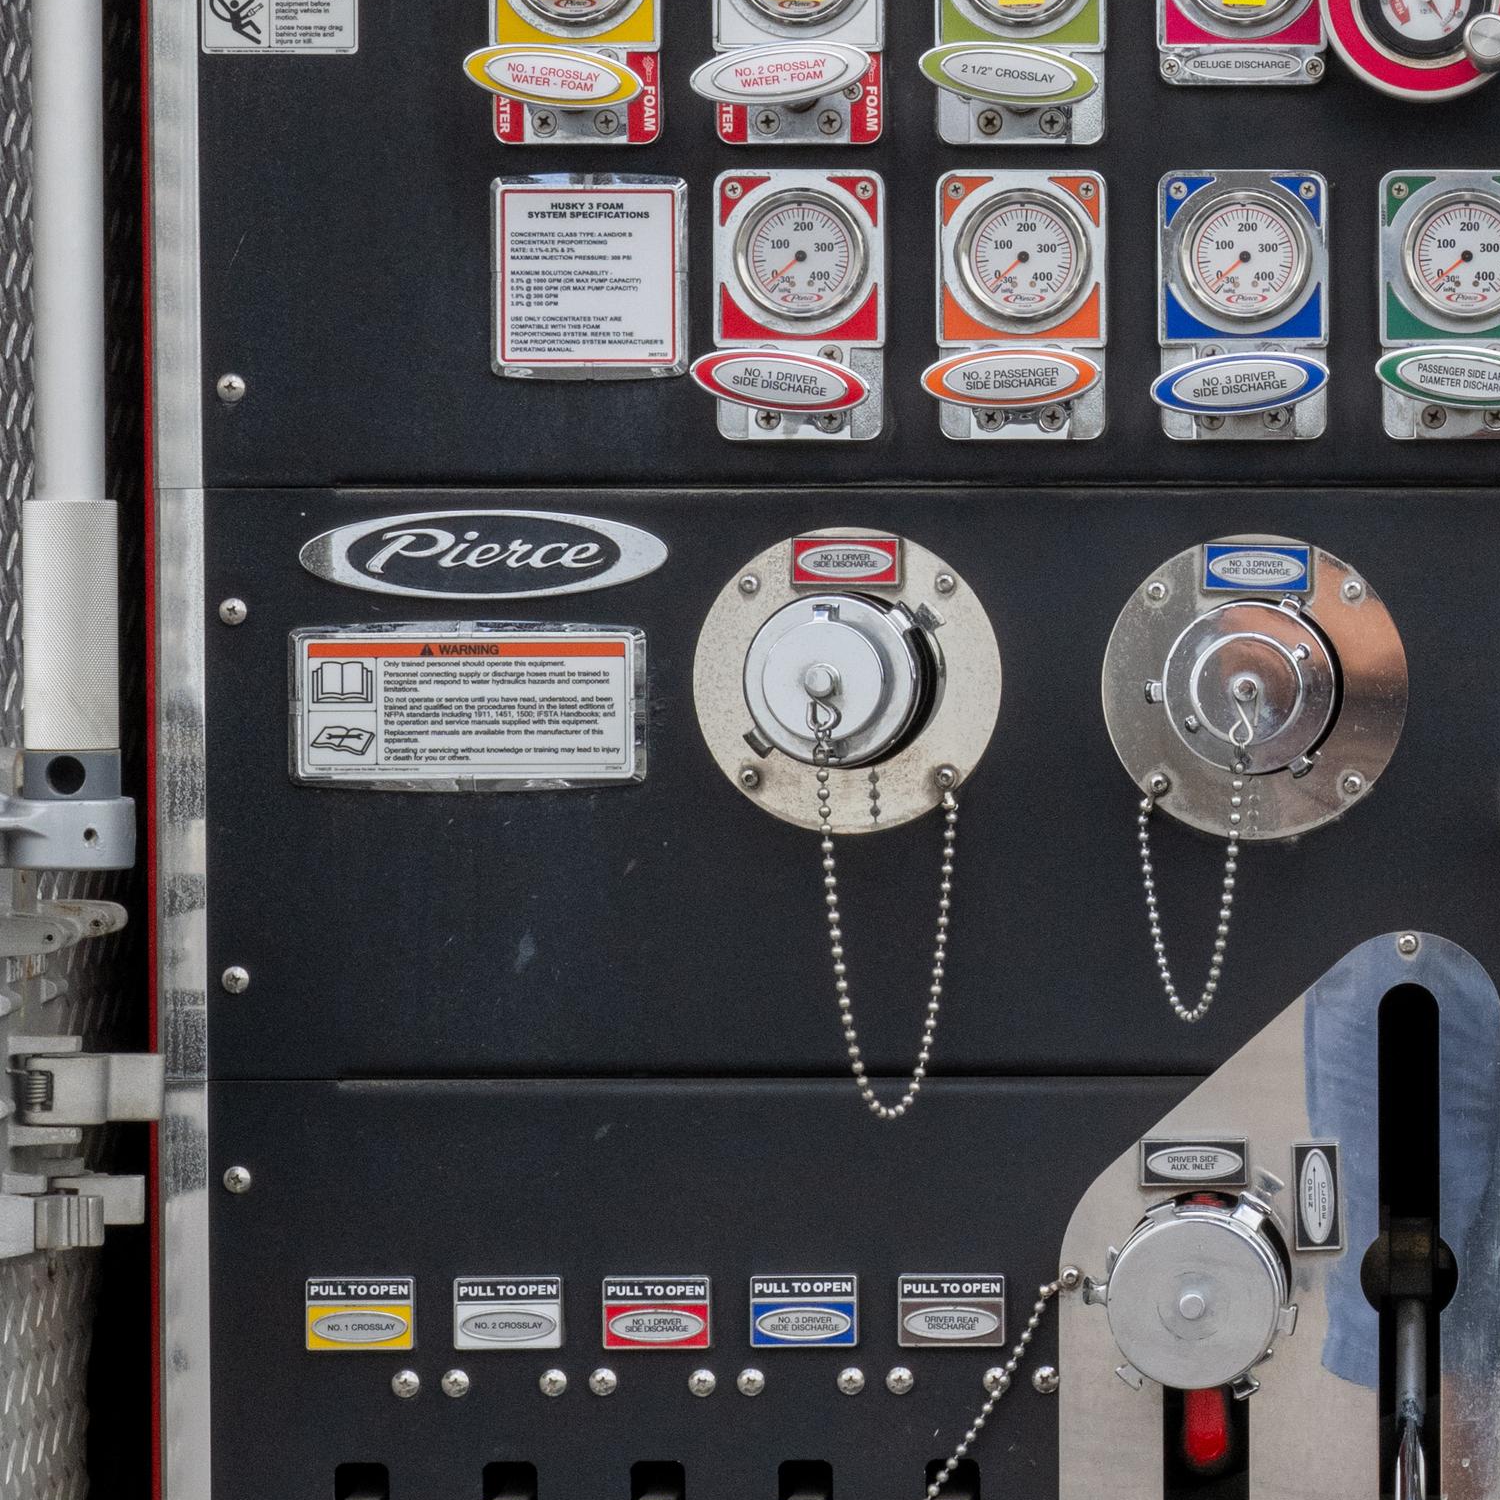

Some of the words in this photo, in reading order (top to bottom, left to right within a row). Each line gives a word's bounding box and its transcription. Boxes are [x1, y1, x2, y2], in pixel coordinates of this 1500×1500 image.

[507, 63, 526, 74] NO.
[538, 67, 600, 81] CROSSLAY
[1193, 60, 1232, 69] DELUGE
[1234, 60, 1291, 69] DISCHARGE
[962, 65, 967, 73] 2
[970, 65, 992, 75] 1/2"
[996, 68, 1055, 83] CROSSLAY
[511, 73, 549, 86] WATER
[560, 80, 593, 92] FOAM
[744, 368, 764, 378] NO.
[775, 372, 817, 384] DRIVER
[1418, 363, 1465, 377] PASSENGER
[1467, 369, 1485, 379] SIDE
[733, 376, 757, 387] SIDE
[760, 379, 827, 396] DISCHARGE
[1419, 375, 1460, 389] DIAMETER
[366, 528, 604, 574] Pierce
[439, 645, 499, 655] WARNING
[311, 1285, 345, 1295] PULL
[349, 1285, 368, 1295] TO
[370, 1285, 408, 1295] OPEN
